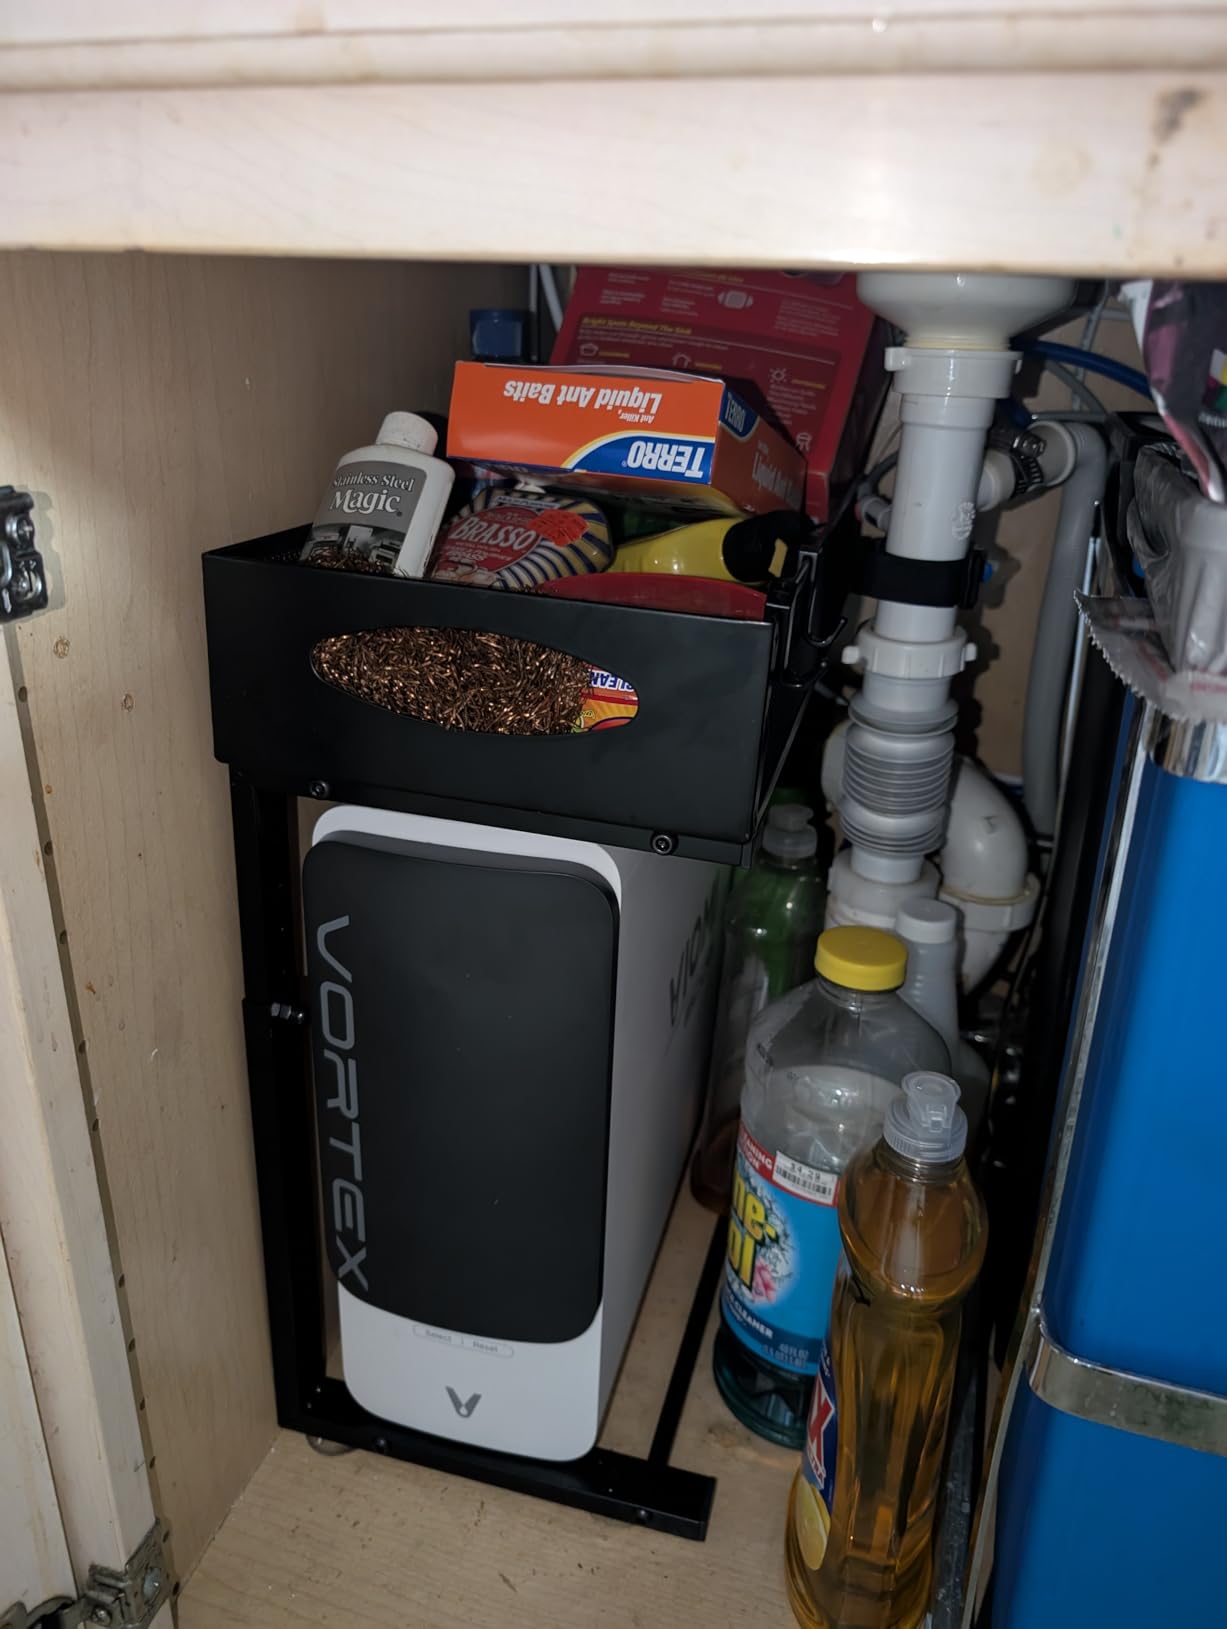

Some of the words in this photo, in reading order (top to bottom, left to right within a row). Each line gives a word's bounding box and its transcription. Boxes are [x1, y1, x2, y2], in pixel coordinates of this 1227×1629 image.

[503, 380, 556, 405] Baits
[557, 386, 595, 409] Ant
[594, 386, 663, 415] Liquid
[626, 440, 706, 479] TERRO
[381, 474, 416, 492] Steel
[328, 489, 401, 515] Magic
[451, 516, 538, 551] BRASSO
[317, 914, 369, 1292] VORTEX
